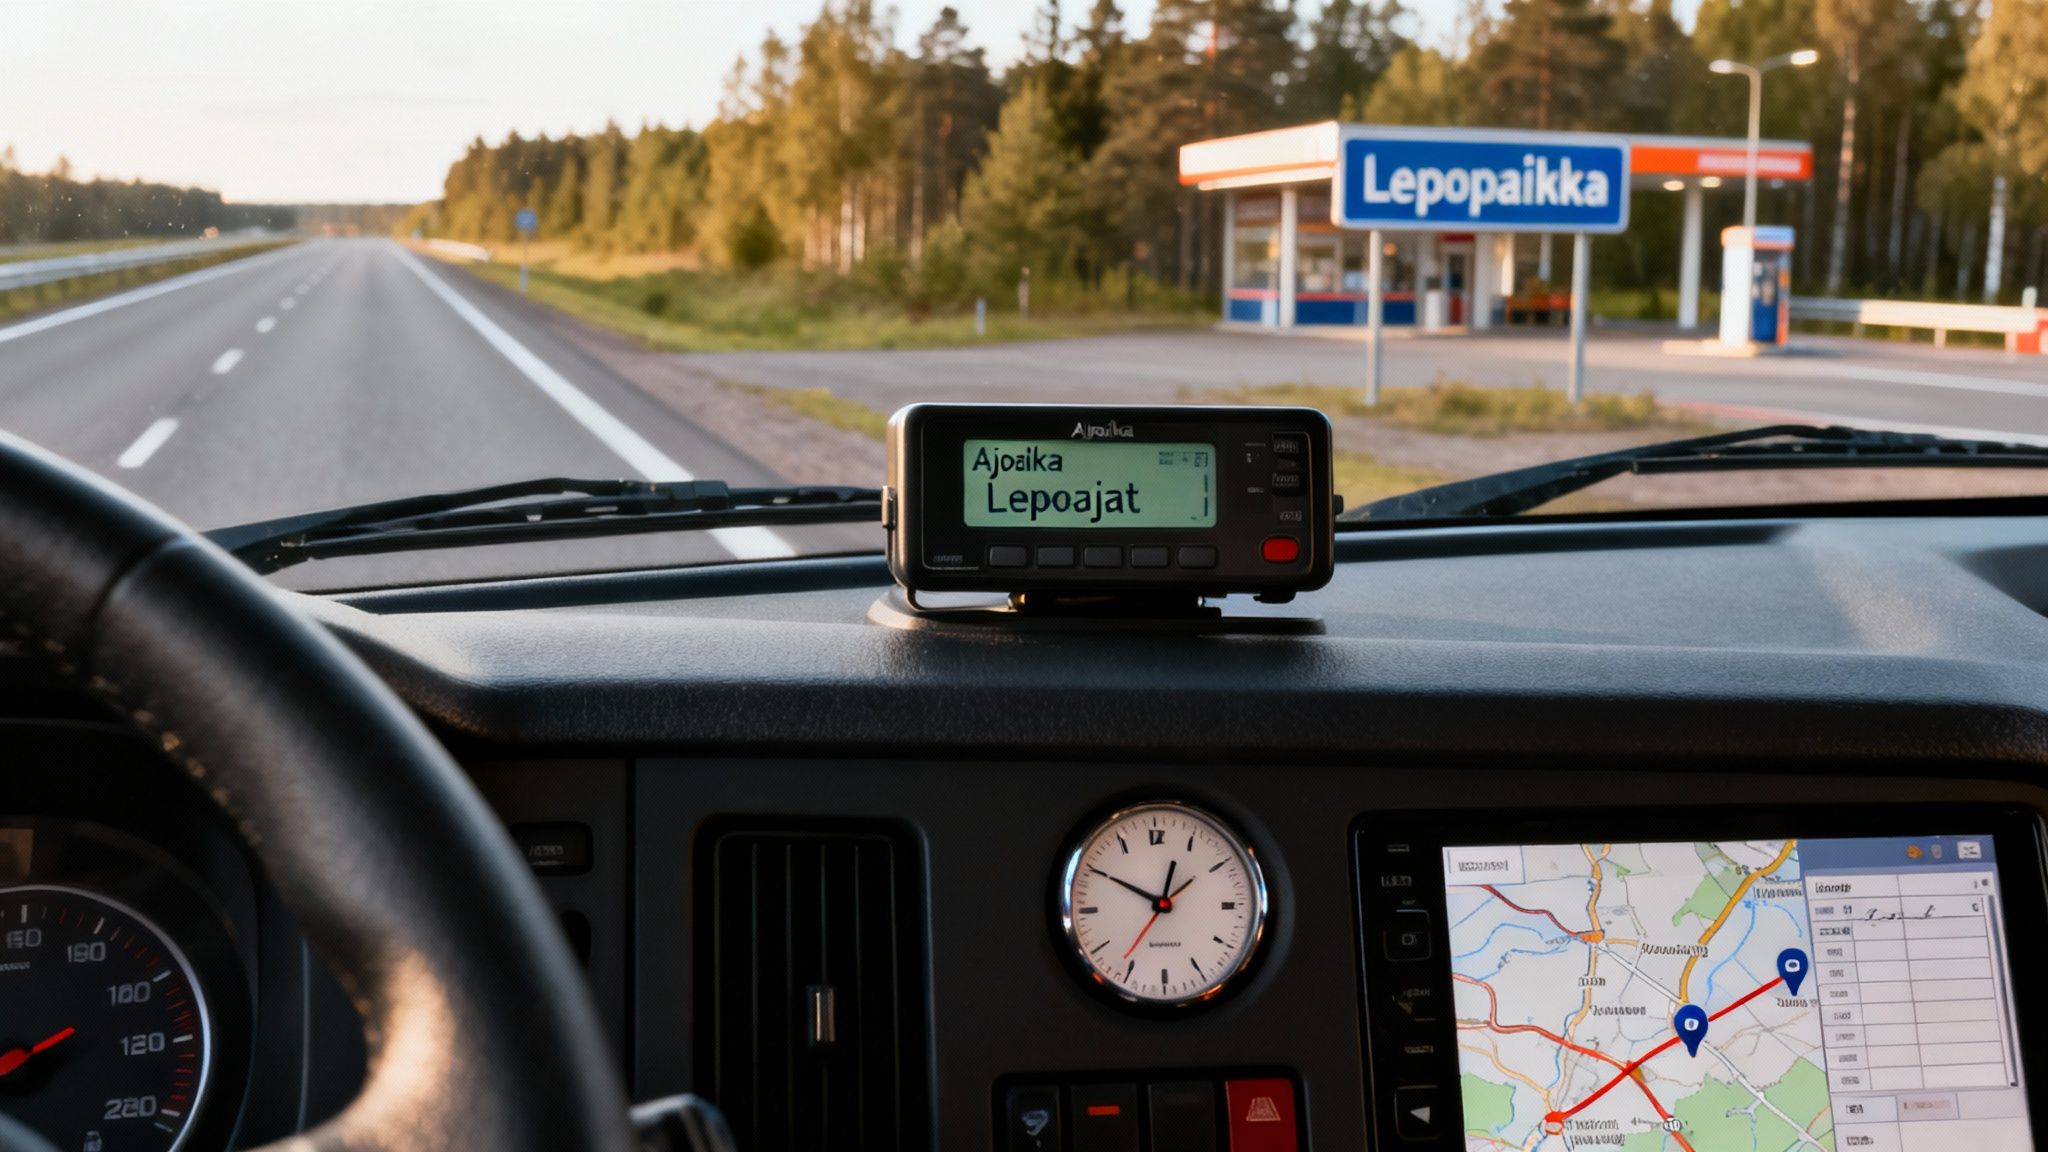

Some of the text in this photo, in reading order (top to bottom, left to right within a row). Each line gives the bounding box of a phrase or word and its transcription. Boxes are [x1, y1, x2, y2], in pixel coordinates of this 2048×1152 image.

[1363, 153, 1609, 218] Lepopaikka
[972, 446, 1063, 480] Ajoaika
[987, 480, 1141, 524] Lepoajat
